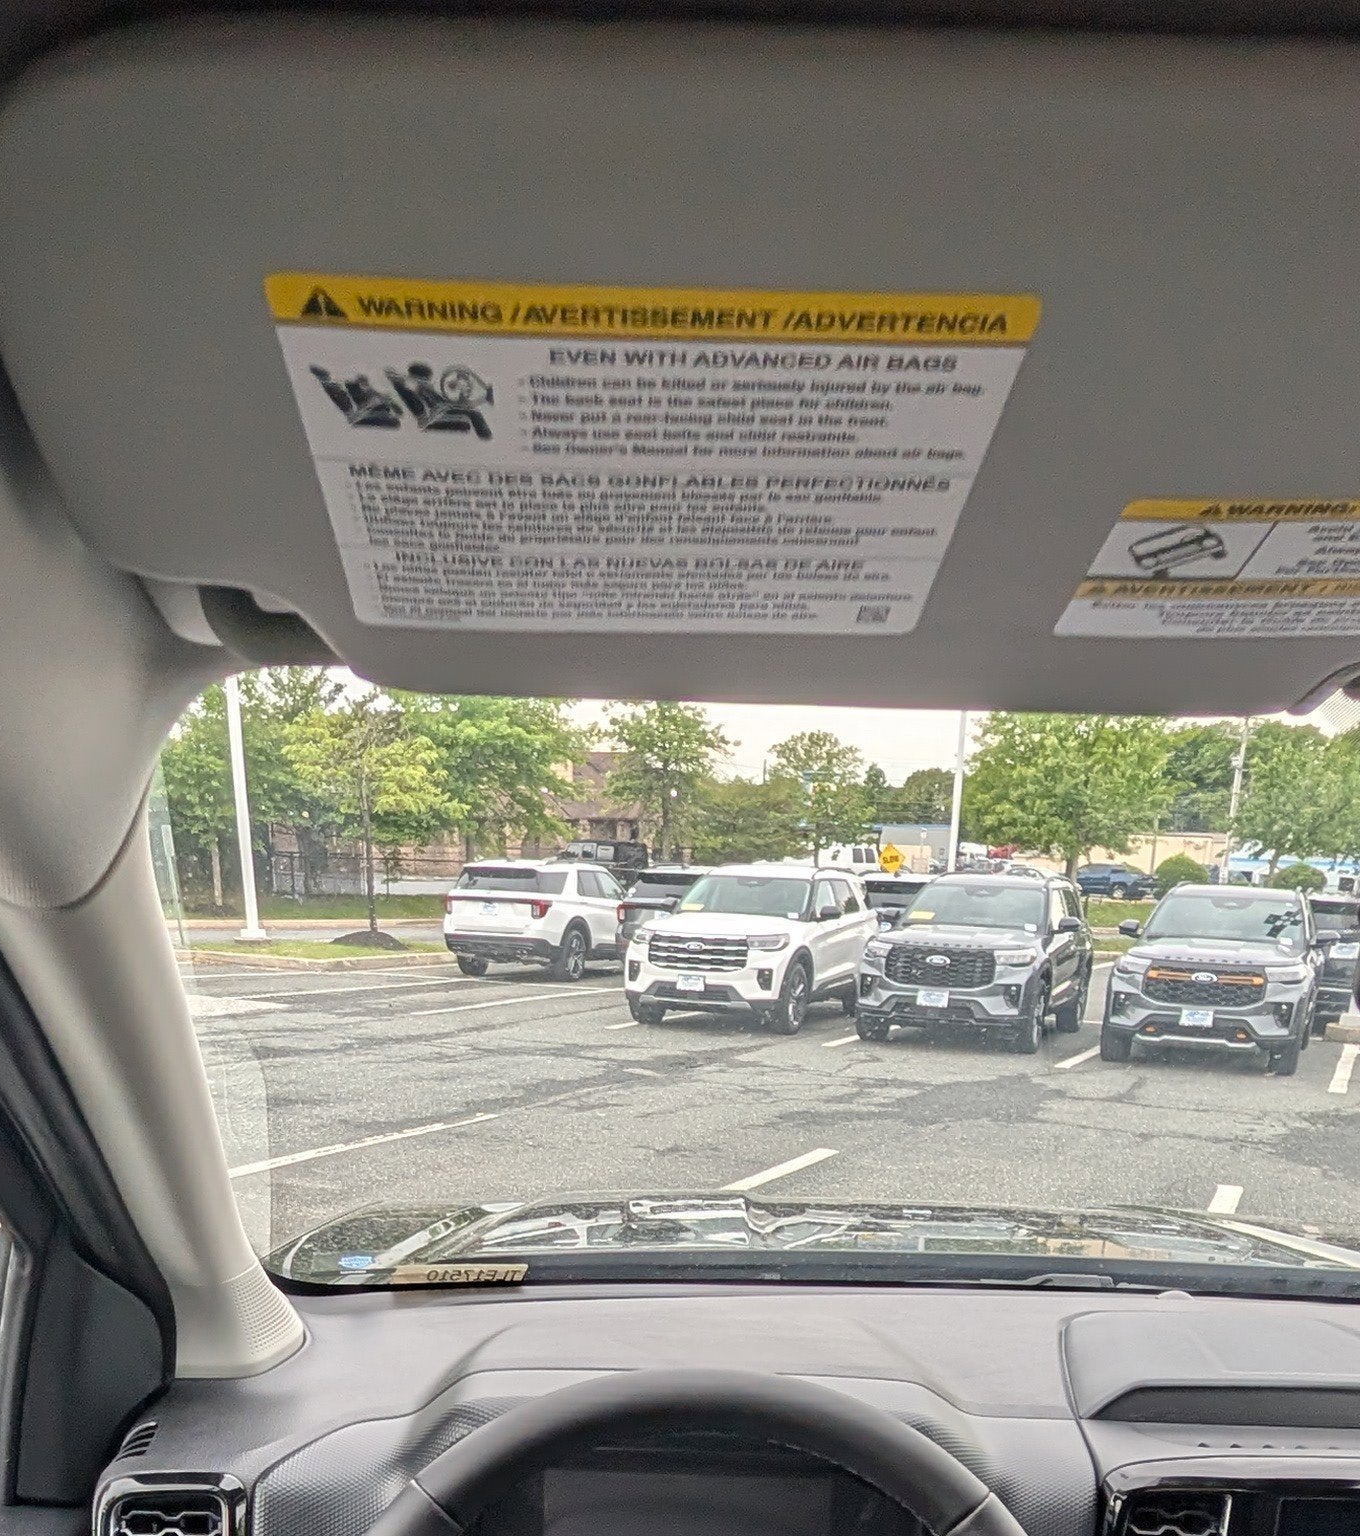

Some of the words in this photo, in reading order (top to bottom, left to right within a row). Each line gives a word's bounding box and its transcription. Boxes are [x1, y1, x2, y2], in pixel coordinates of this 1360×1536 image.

[357, 296, 503, 324] WARNING
[549, 348, 616, 365] EVEN
[624, 349, 687, 367] WITH
[693, 350, 831, 370] ADVANCED
[836, 353, 880, 371] AIR
[886, 354, 958, 372] BAGS
